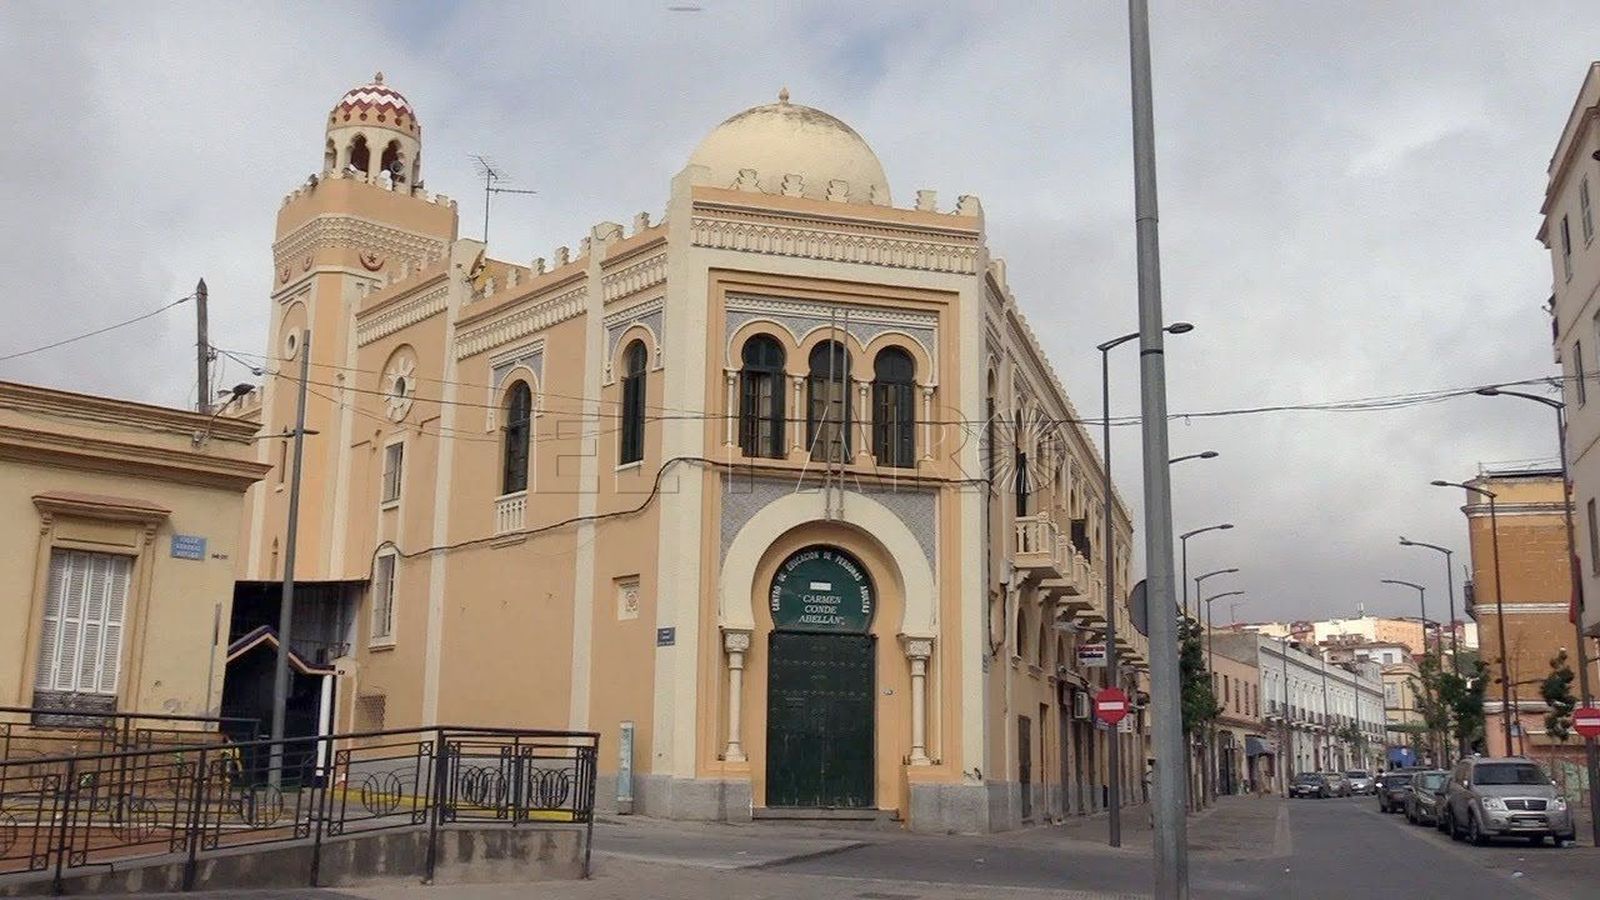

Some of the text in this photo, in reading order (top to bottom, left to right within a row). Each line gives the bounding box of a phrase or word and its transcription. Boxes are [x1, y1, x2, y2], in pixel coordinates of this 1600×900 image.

[772, 585, 782, 611] CENTRO
[777, 573, 787, 582] DE
[823, 551, 832, 560] DE
[835, 555, 863, 581] PERSONAS
[805, 605, 837, 614] CONDE
